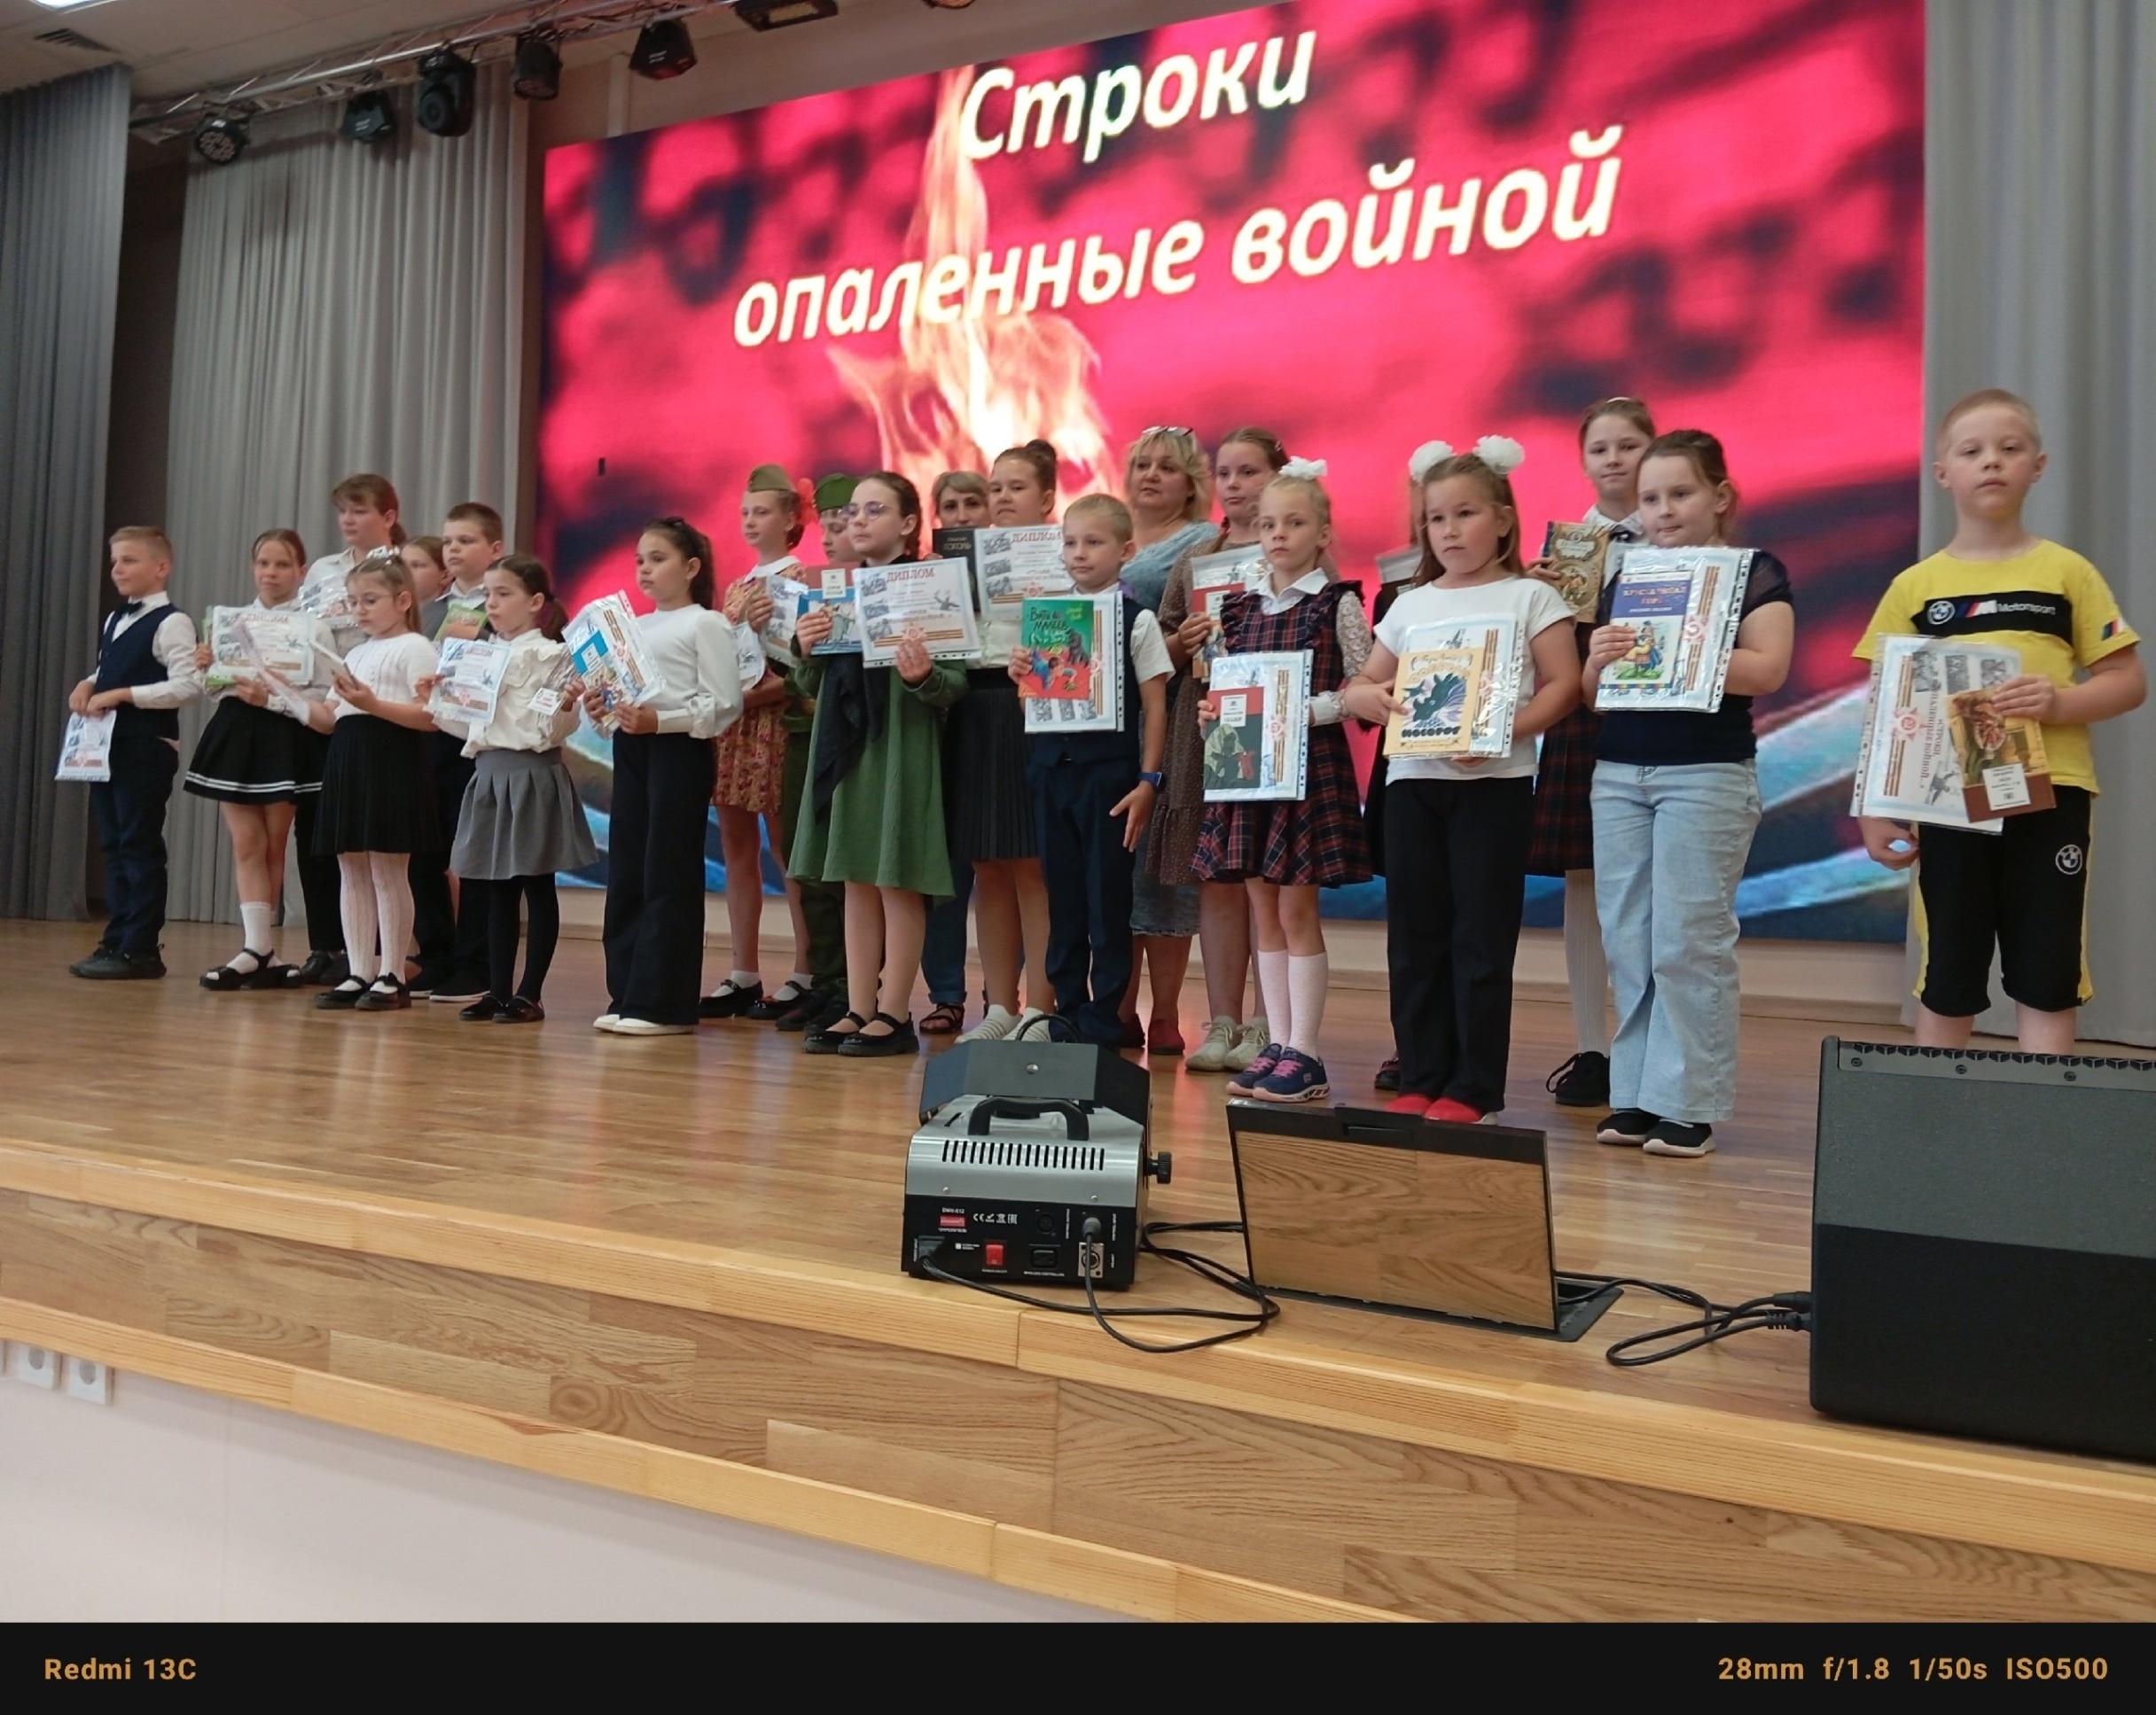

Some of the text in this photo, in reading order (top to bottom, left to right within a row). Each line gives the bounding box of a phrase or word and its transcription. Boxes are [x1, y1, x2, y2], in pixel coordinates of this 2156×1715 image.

[959, 30, 1316, 163] Строки
[733, 124, 1623, 347] опаленные войной
[887, 567, 935, 582] ДИПЛОМ
